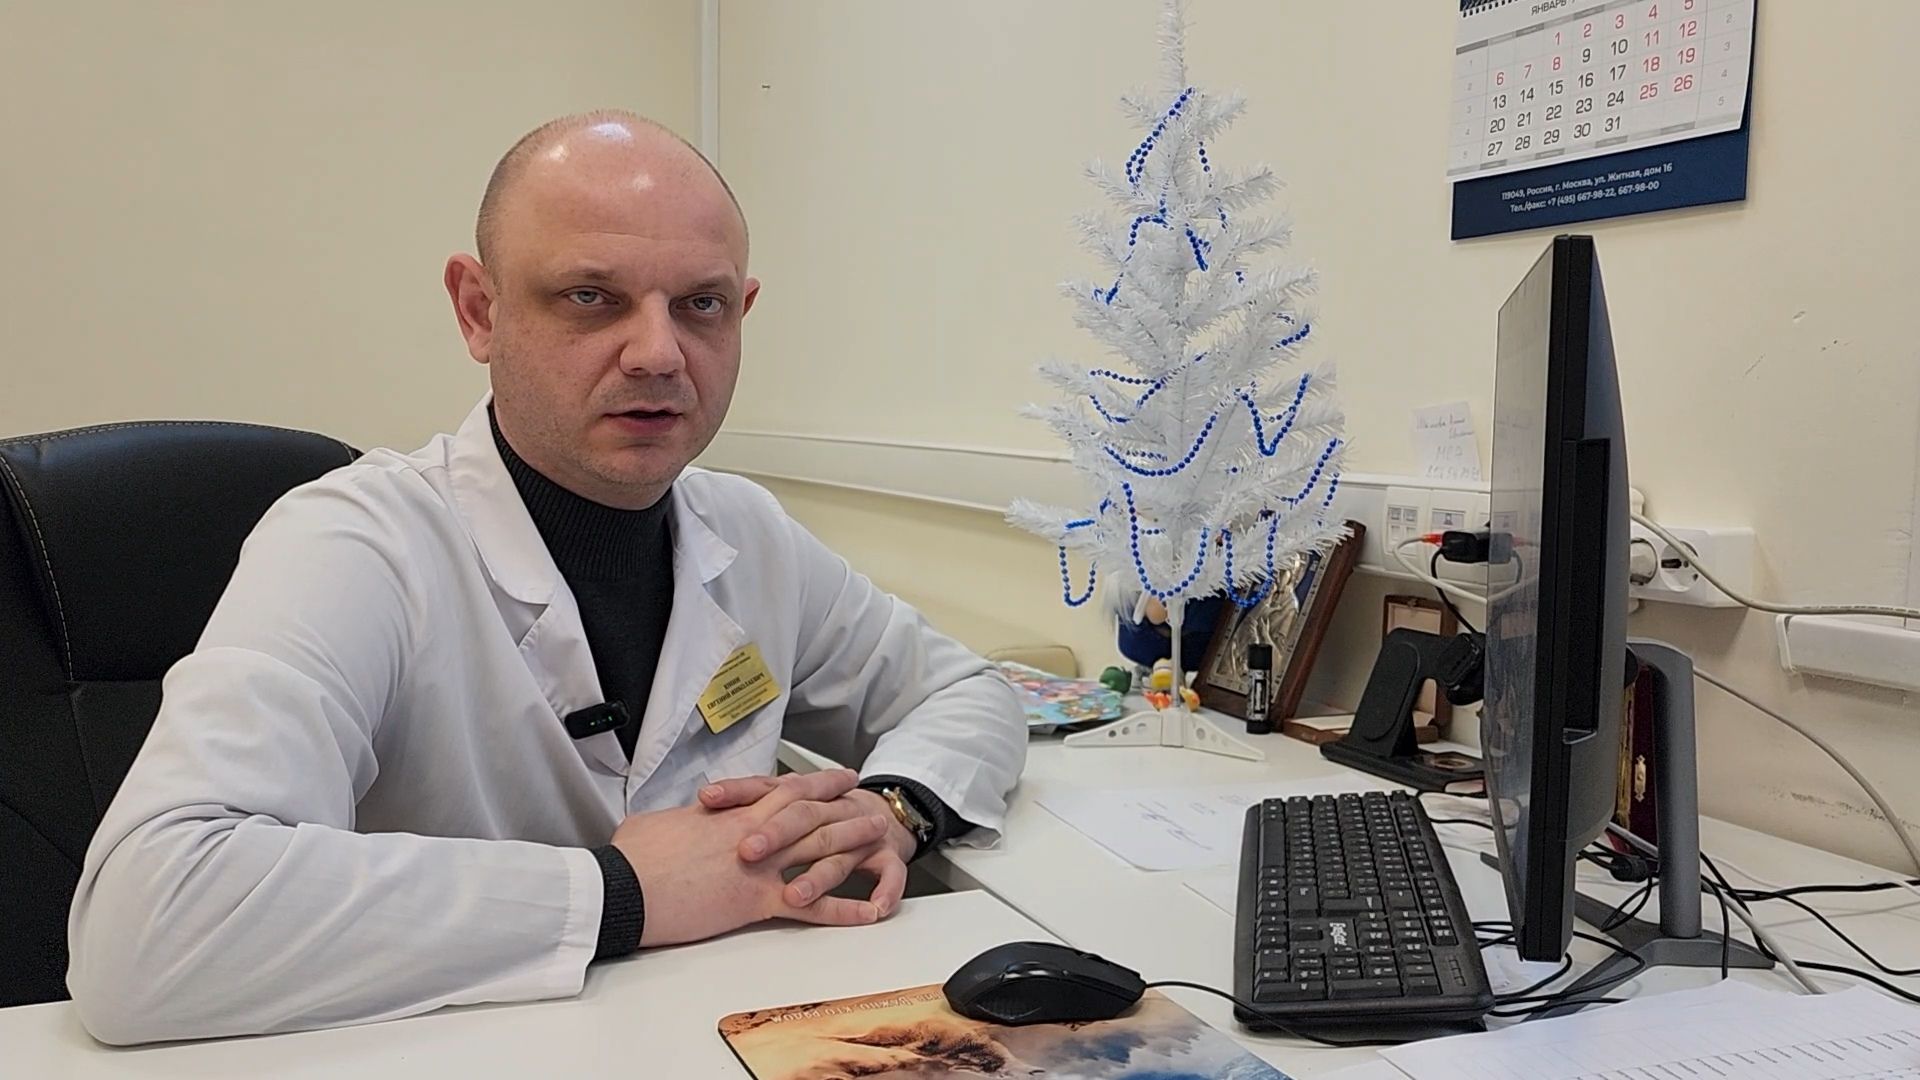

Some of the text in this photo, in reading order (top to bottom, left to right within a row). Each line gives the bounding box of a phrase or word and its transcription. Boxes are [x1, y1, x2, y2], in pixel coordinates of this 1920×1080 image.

[1530, 0, 1566, 15] ЯНВАРЬ
[1554, 32, 1561, 45] 1
[1583, 23, 1592, 38] 2
[1615, 14, 1624, 29] 3
[1648, 4, 1658, 19] 4
[1684, 0, 1694, 10] 5
[1496, 72, 1505, 86] 6
[1524, 64, 1532, 79] 7
[1552, 57, 1561, 71] 8
[1582, 48, 1591, 63] 9
[1610, 39, 1628, 56] 10
[1644, 30, 1660, 47] 11
[1679, 20, 1697, 38] 12
[1492, 94, 1507, 109] 13
[1520, 87, 1534, 103] 14
[1548, 80, 1564, 96] 15
[1578, 72, 1594, 88] 16
[1609, 64, 1627, 81] 17
[1642, 56, 1660, 73] 18
[1677, 47, 1696, 64] 19
[1490, 118, 1506, 134] 20
[1517, 112, 1532, 128] 21
[1545, 105, 1562, 121] 22
[1575, 98, 1593, 114] 23
[1606, 90, 1625, 107] 24
[1640, 83, 1658, 100] 25
[1673, 75, 1693, 92] 26
[1487, 141, 1503, 156] 27
[1514, 135, 1531, 151] 28
[1543, 129, 1560, 145] 29
[1573, 122, 1591, 139] 30
[1604, 116, 1621, 132] 31
[1510, 180, 1660, 213] Тел./факс: +7 (495) 667-98-22, 667-98-00
[1526, 185, 1555, 196] Россия,
[1555, 183, 1561, 191] г.
[1562, 178, 1593, 190] Москва,
[1594, 176, 1606, 187] ул.
[1607, 169, 1643, 182] Житная,
[1643, 165, 1662, 177] дом
[1663, 162, 1673, 173] 16
